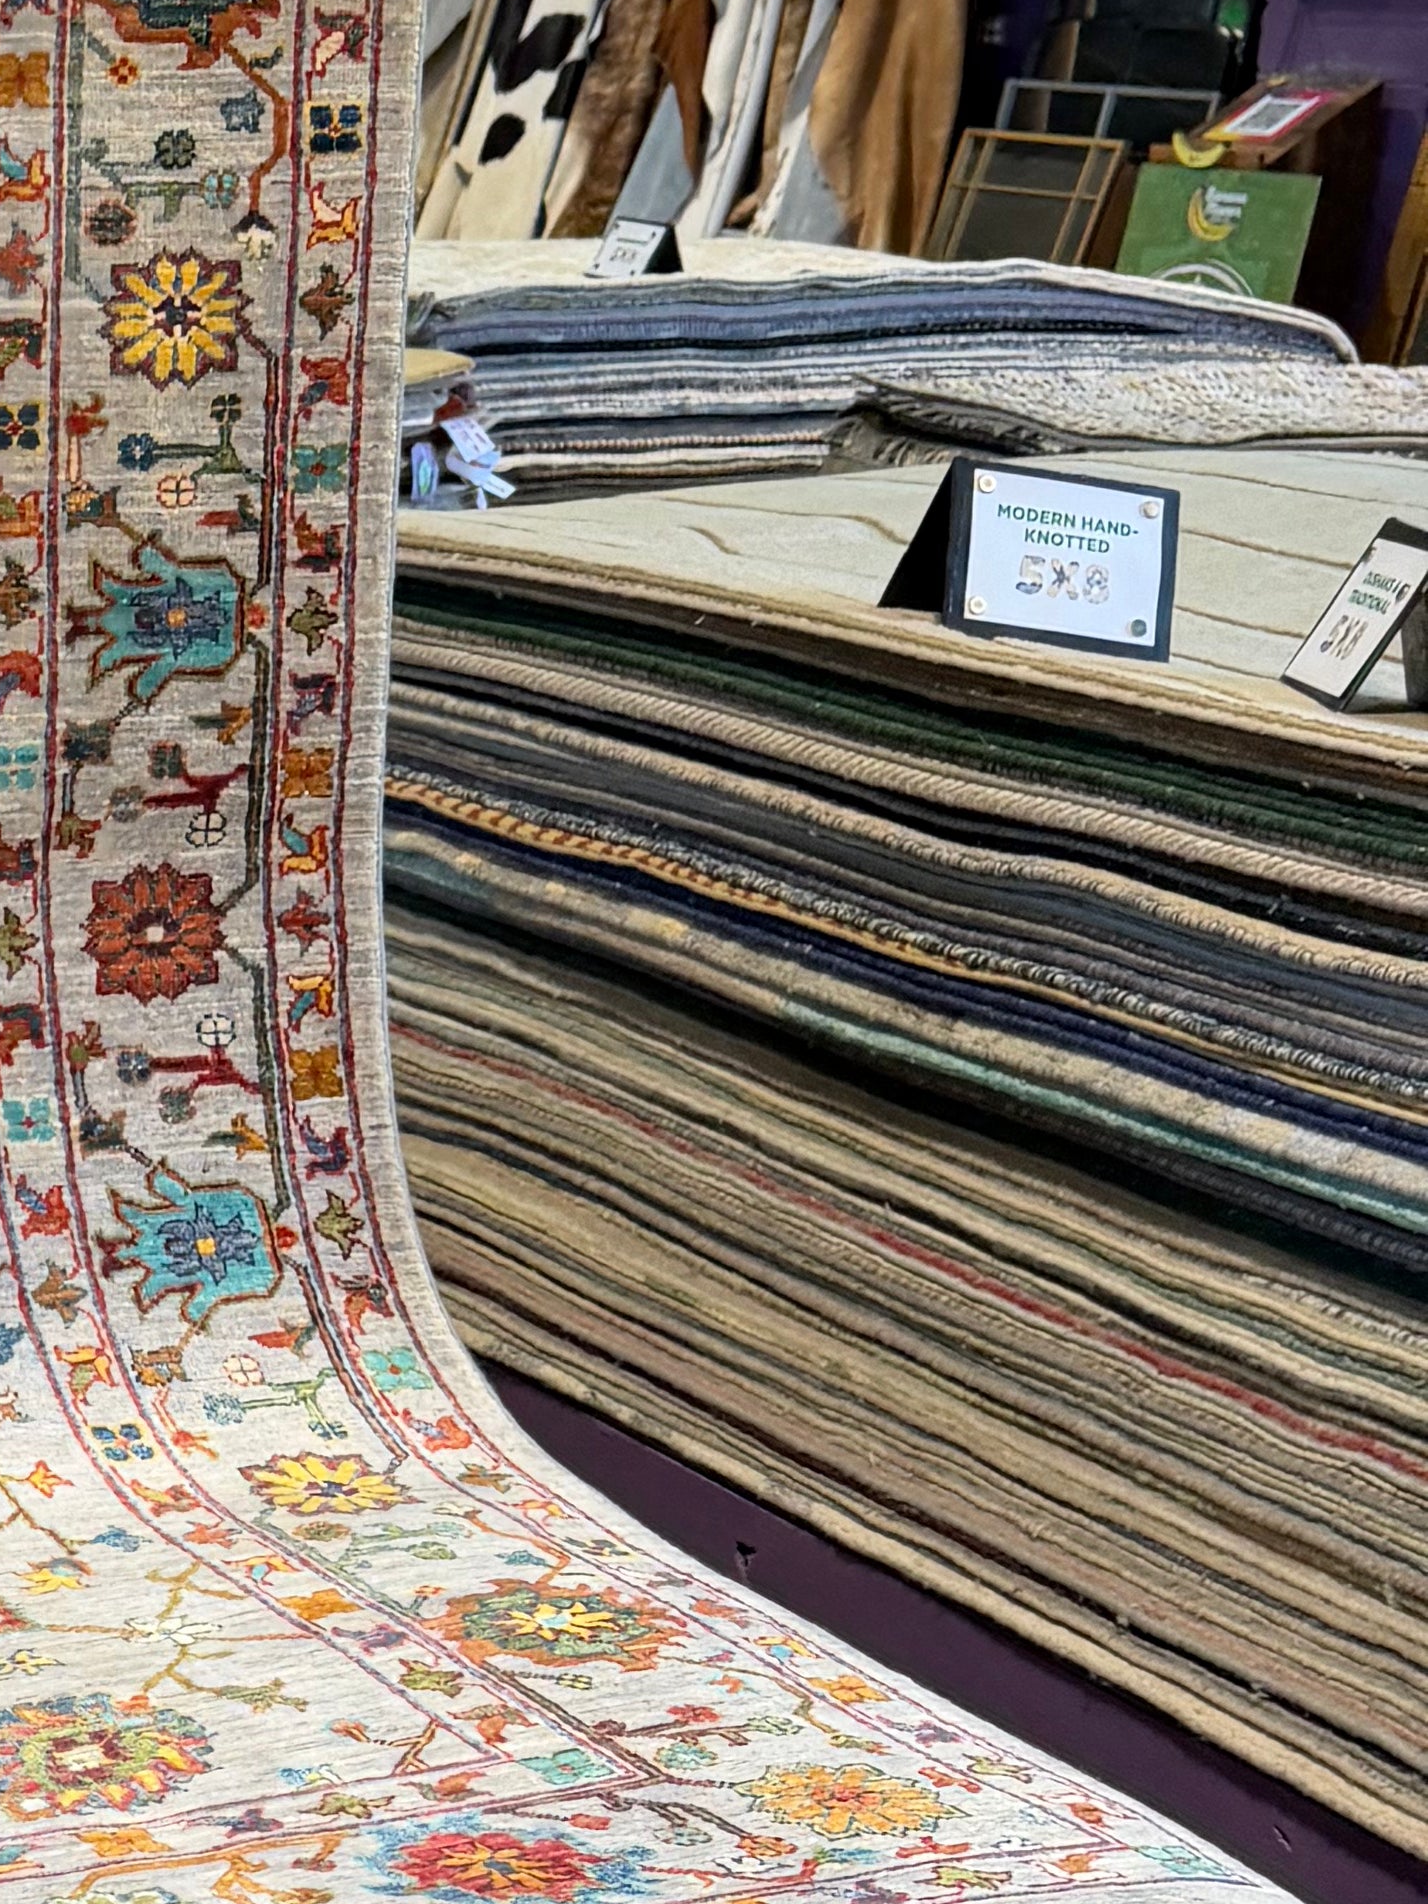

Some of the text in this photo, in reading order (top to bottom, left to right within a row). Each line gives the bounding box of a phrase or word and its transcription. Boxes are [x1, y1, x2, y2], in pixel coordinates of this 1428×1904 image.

[997, 503, 1140, 537] MODERN HAND-
[1023, 528, 1110, 554] KNOTTED
